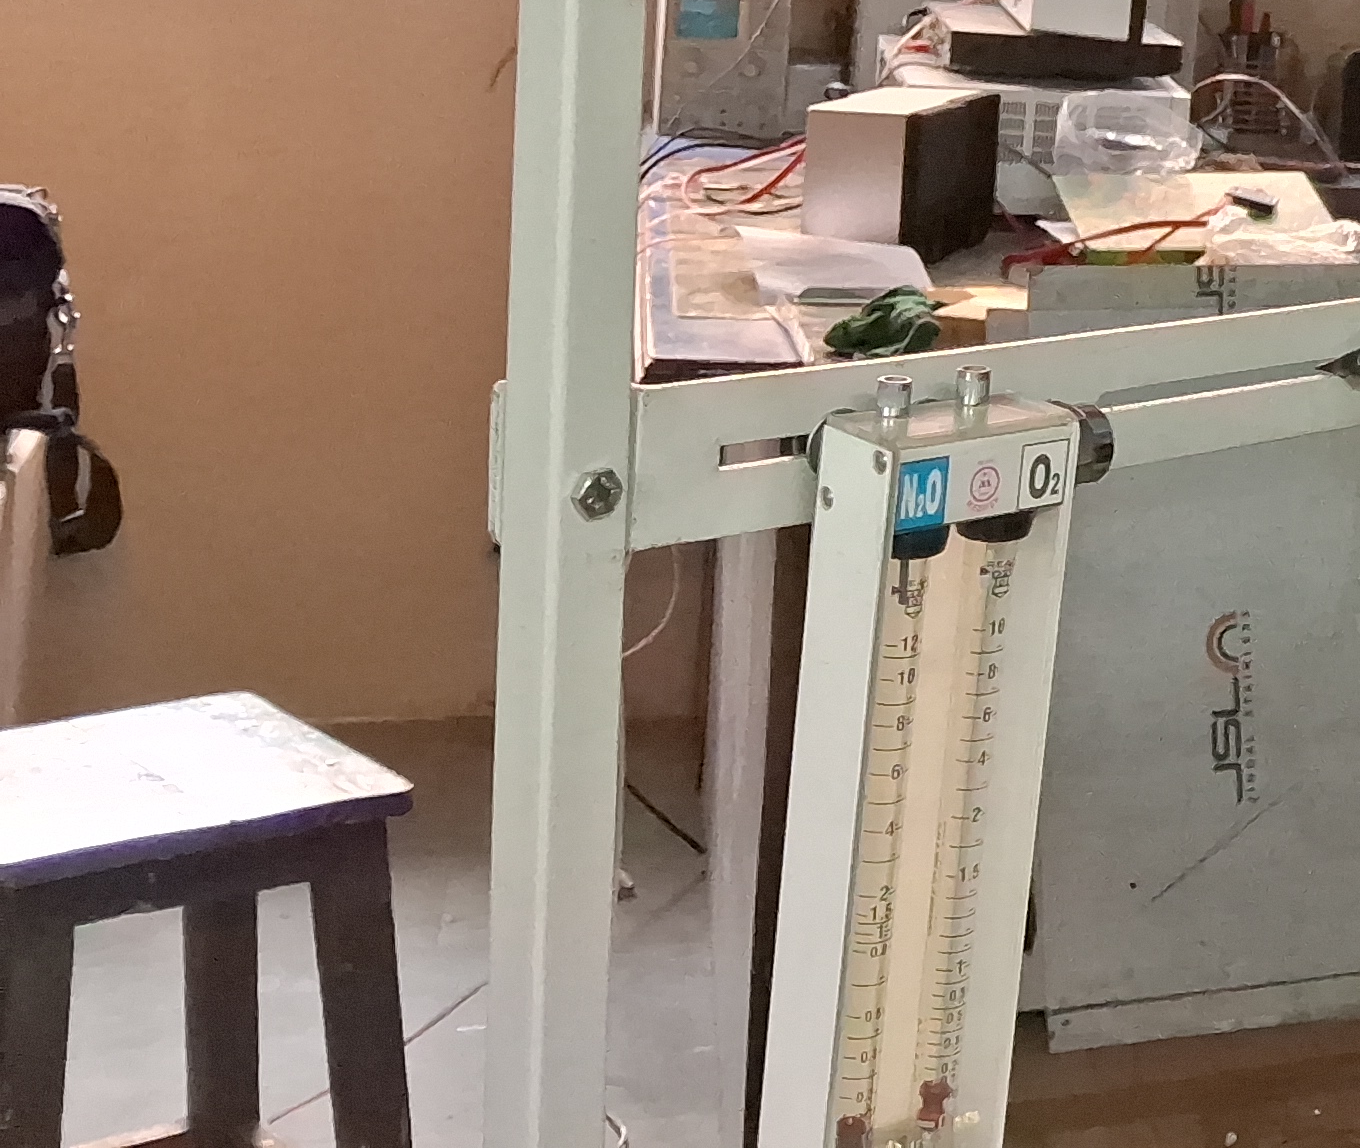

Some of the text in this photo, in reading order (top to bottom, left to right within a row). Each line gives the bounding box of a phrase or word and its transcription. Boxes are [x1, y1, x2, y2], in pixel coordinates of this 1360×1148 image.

[988, 617, 1006, 637] 10
[900, 634, 919, 653] 12
[898, 667, 916, 685] 10
[1211, 675, 1244, 806] JSL
